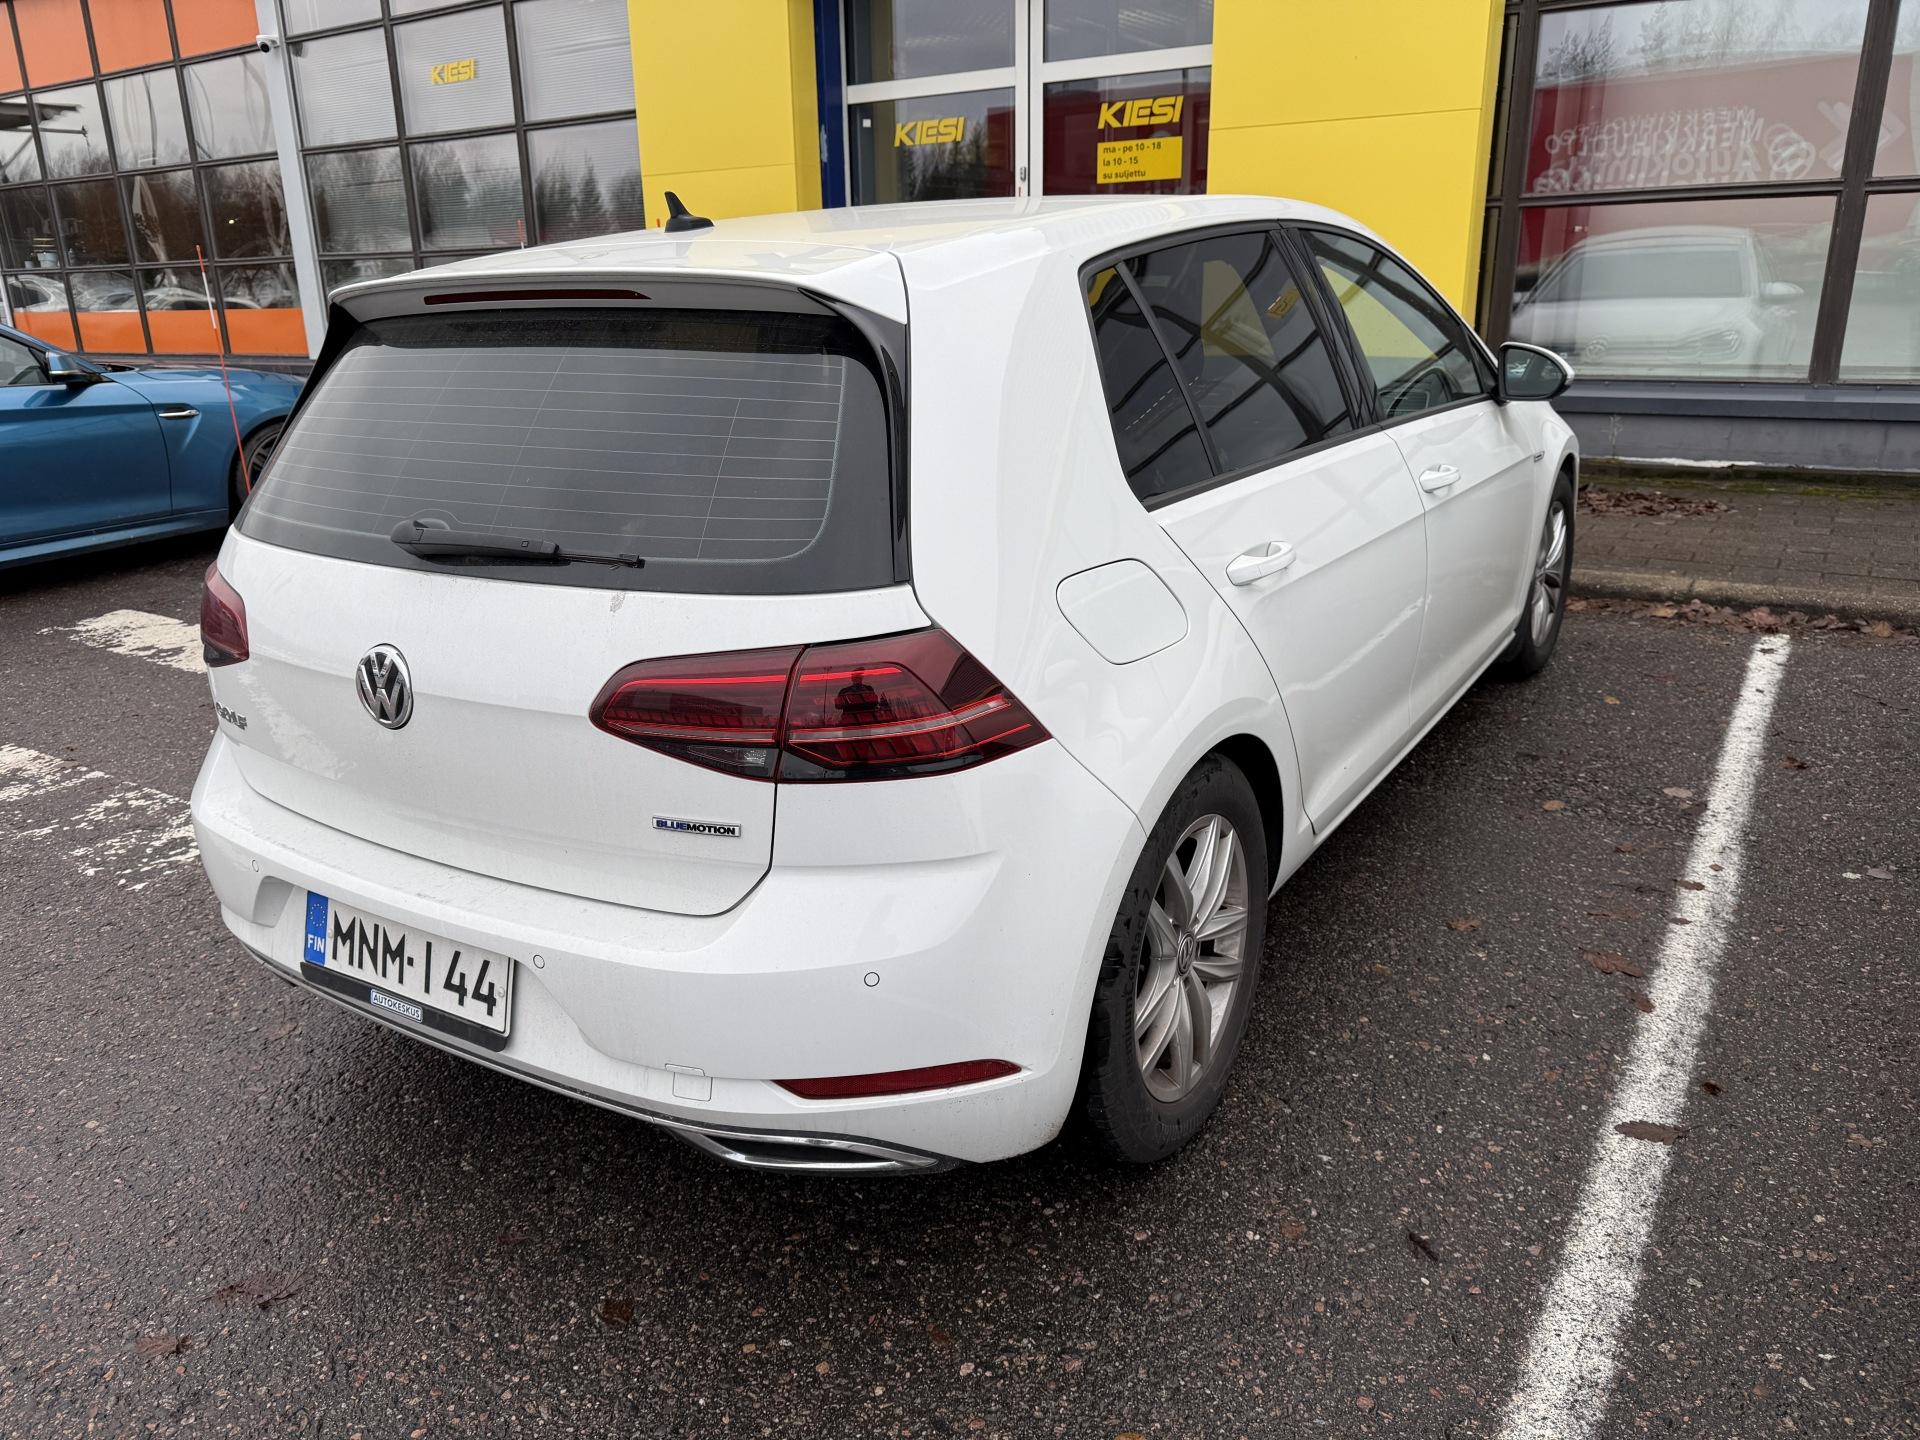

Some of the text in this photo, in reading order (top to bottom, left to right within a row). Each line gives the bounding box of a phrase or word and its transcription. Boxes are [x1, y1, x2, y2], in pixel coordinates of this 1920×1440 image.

[431, 59, 475, 85] KIESI
[1097, 95, 1184, 129] KIESI
[894, 116, 965, 147] KIESI
[1103, 146, 1117, 154] ma
[1122, 145, 1134, 155] pe
[1135, 142, 1145, 151] 10
[1152, 141, 1162, 151] 18
[1113, 157, 1122, 166] 10
[1129, 156, 1139, 165] 15
[1114, 170, 1146, 179] suljettu
[656, 819, 735, 835] BLUEMOTION
[307, 933, 325, 954] FIN
[332, 910, 497, 1017] MNM-144
[373, 994, 420, 1019] AUTOKESKUS
